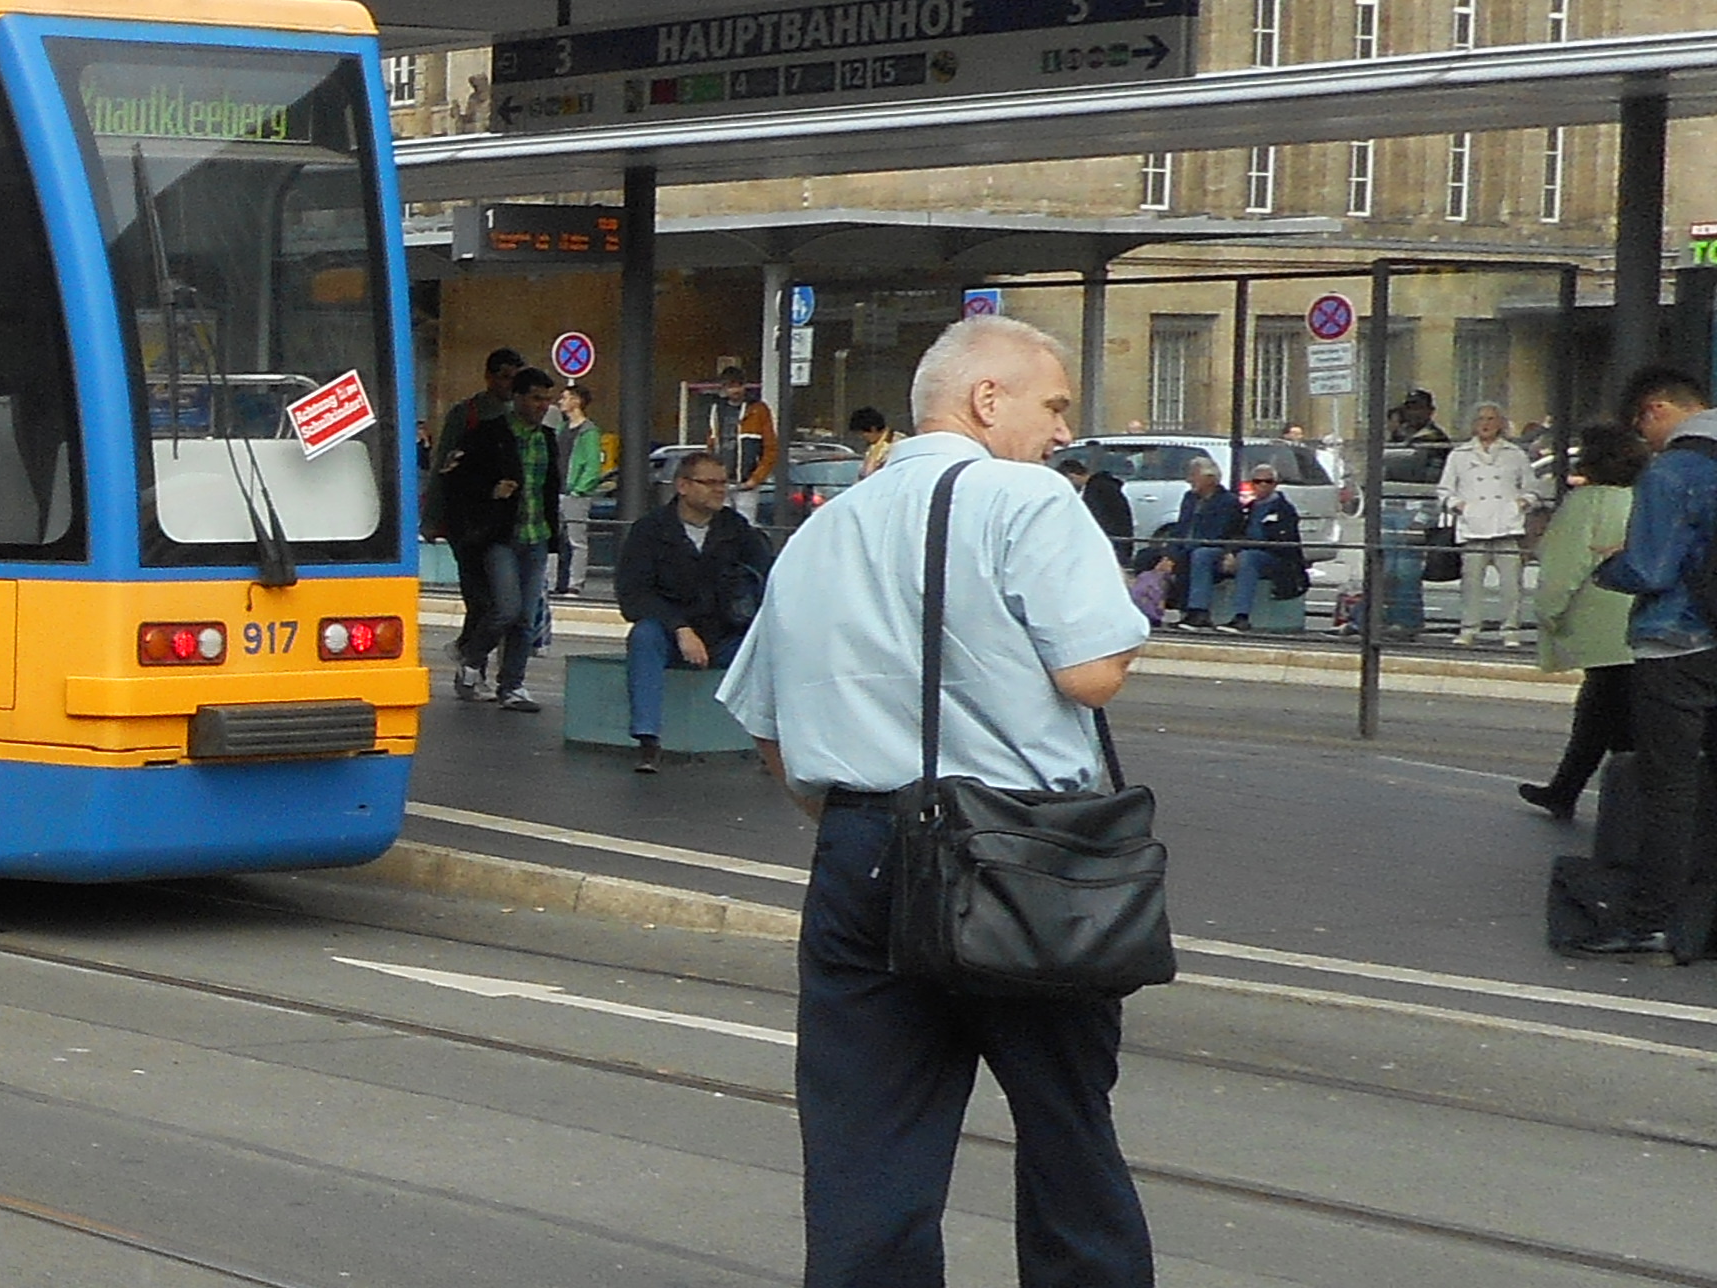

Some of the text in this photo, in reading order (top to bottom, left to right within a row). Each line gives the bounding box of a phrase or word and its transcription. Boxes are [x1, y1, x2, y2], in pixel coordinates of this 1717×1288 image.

[555, 38, 573, 76] 3
[735, 74, 747, 93] 4
[790, 68, 803, 90] 7
[842, 63, 864, 86] 12
[872, 62, 896, 84] 15
[485, 209, 495, 229] 1
[243, 621, 299, 655] 917
